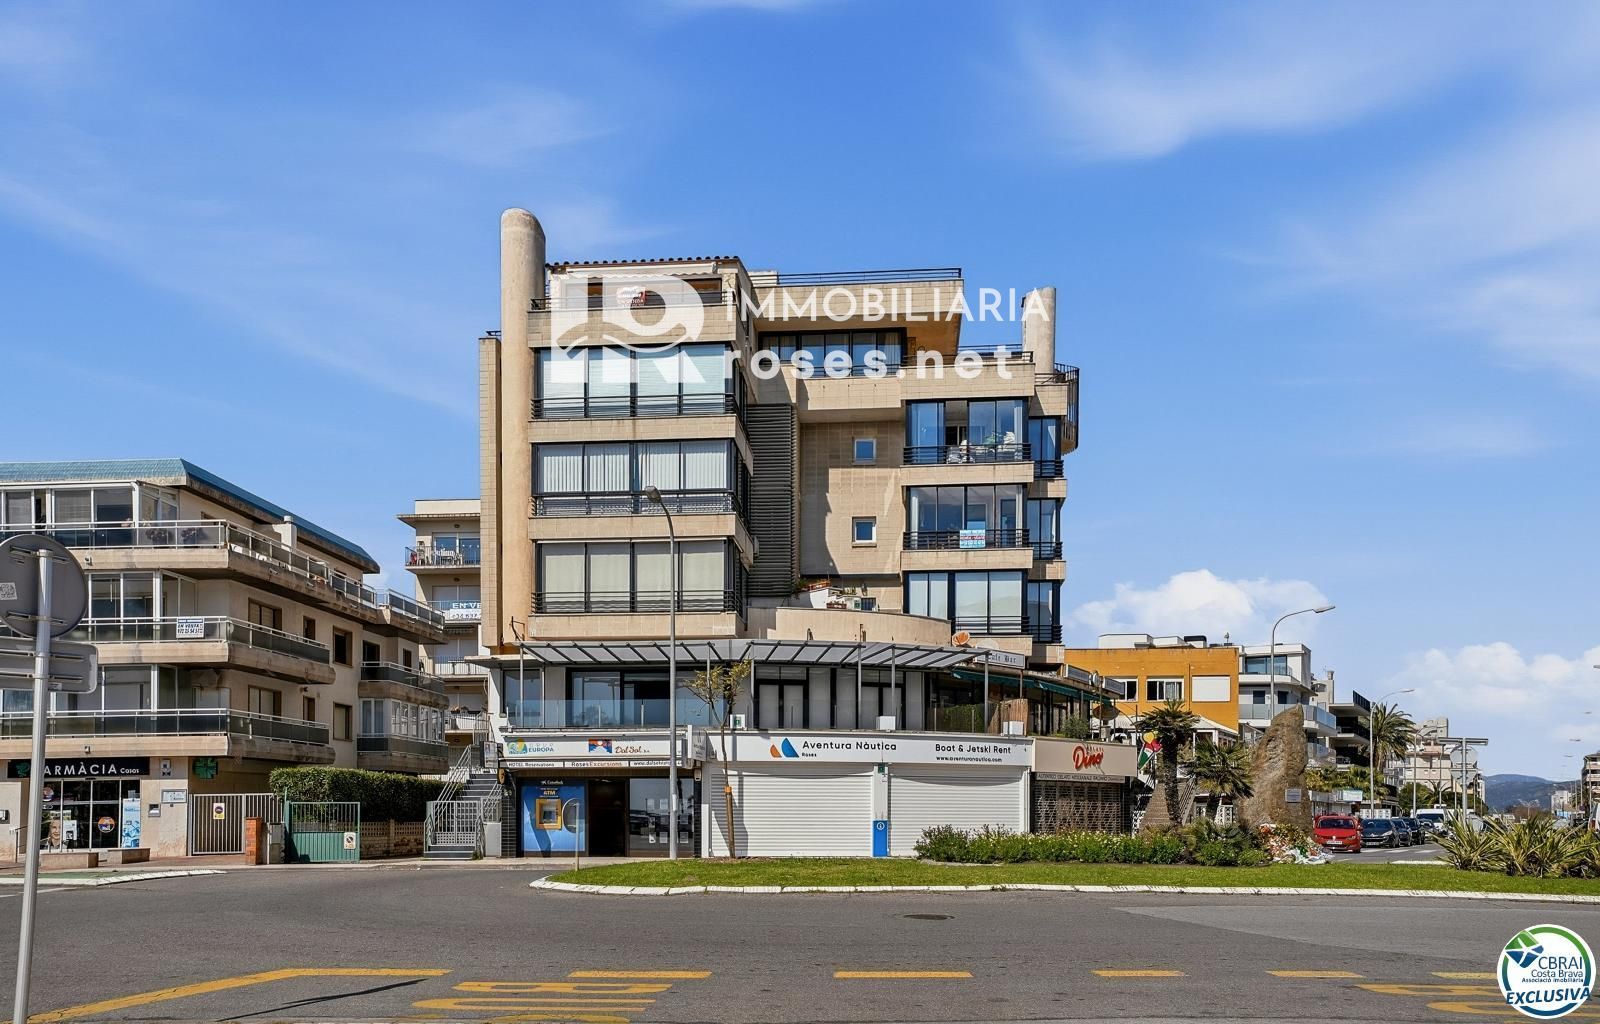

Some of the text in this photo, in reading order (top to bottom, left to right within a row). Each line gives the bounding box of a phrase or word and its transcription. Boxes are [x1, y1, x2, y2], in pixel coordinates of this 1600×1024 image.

[802, 740, 897, 750] Aventura Nàutica
[935, 744, 956, 752] Boat
[966, 745, 991, 753] Jetski
[994, 746, 1011, 754] Rent
[43, 762, 117, 775] ARMÀCIA
